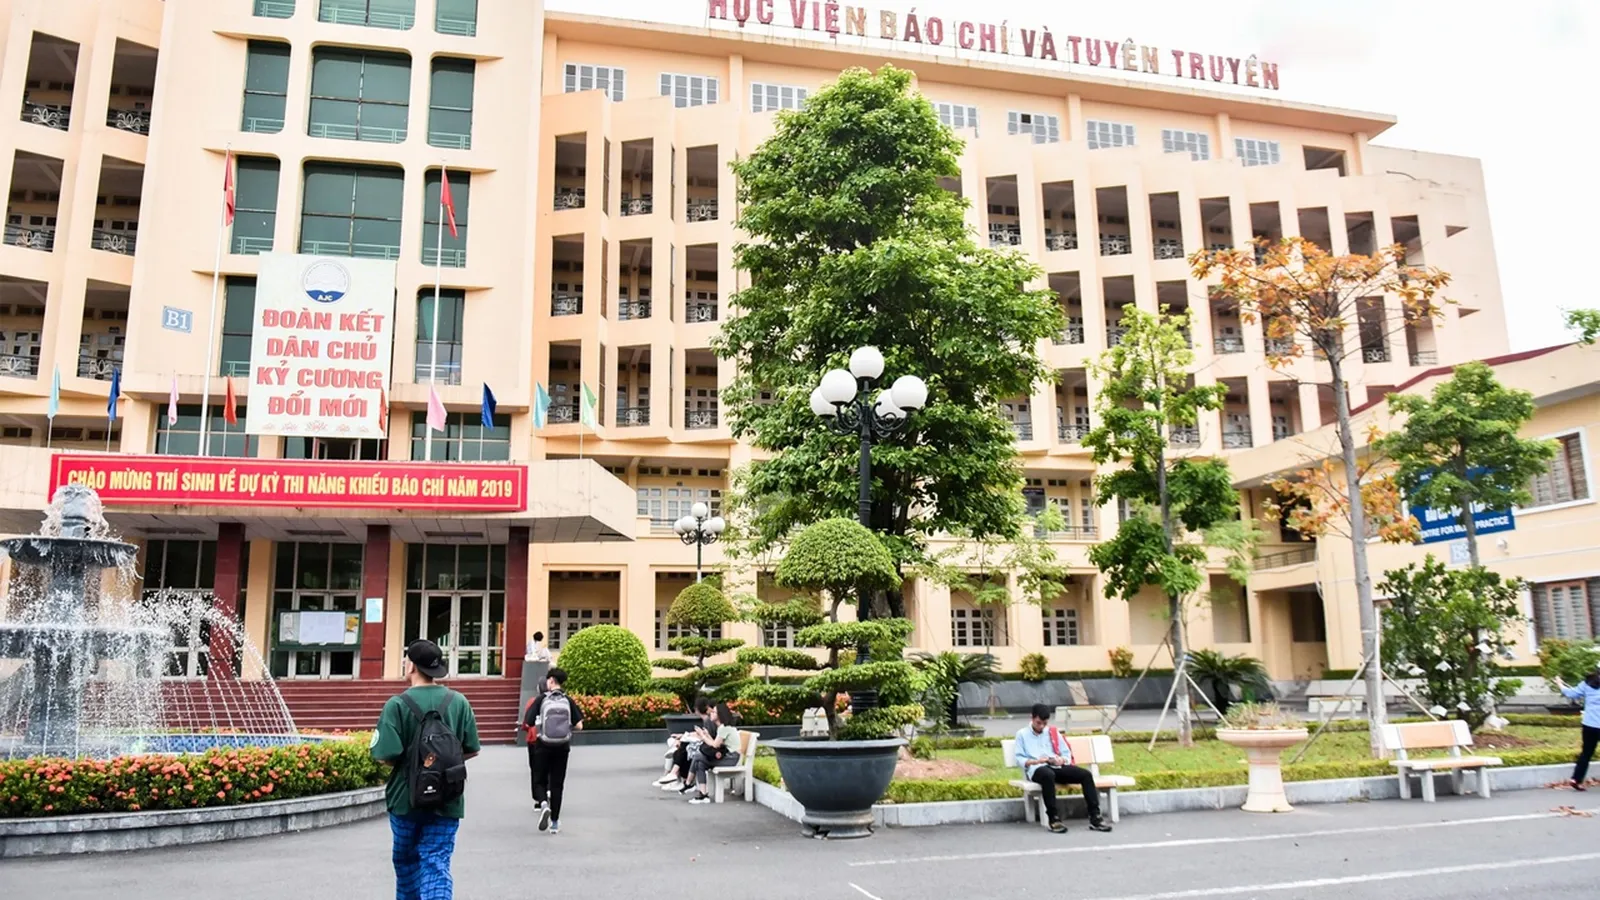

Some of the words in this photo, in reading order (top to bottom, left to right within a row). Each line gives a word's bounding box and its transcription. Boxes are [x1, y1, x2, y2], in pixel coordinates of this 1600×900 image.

[708, 0, 774, 28] HỌC
[789, 0, 865, 39] VIỆN
[879, 7, 944, 46] BÁO
[958, 20, 1008, 54] CHÍ
[1020, 25, 1058, 60] VÀ
[1067, 35, 1160, 74] TUYÊN
[165, 309, 188, 330] B1
[262, 307, 332, 330] ĐOÀN
[339, 308, 385, 333] KẾT
[266, 335, 319, 358] DÂN
[327, 335, 377, 361] CHỦ
[256, 360, 289, 386] KỶ
[297, 368, 383, 390] CƯƠNG
[268, 390, 311, 416] ĐỔI
[319, 394, 368, 418] MỚI
[68, 466, 106, 490] CHÀO
[109, 467, 152, 491] MỪNG
[156, 467, 179, 491] THÍ
[181, 472, 216, 492] SINH
[239, 472, 261, 497] DỰ
[283, 475, 304, 494] THI
[307, 472, 346, 495] NĂNG
[349, 471, 389, 496] KHIẾU
[392, 473, 419, 496] BÁO
[422, 474, 445, 497] CHÍ
[448, 475, 478, 497] NĂM
[481, 479, 513, 498] 2019
[1420, 528, 1440, 540] ENTRE
[1441, 525, 1454, 535] FOR
[1475, 515, 1509, 529] PRACTICE
